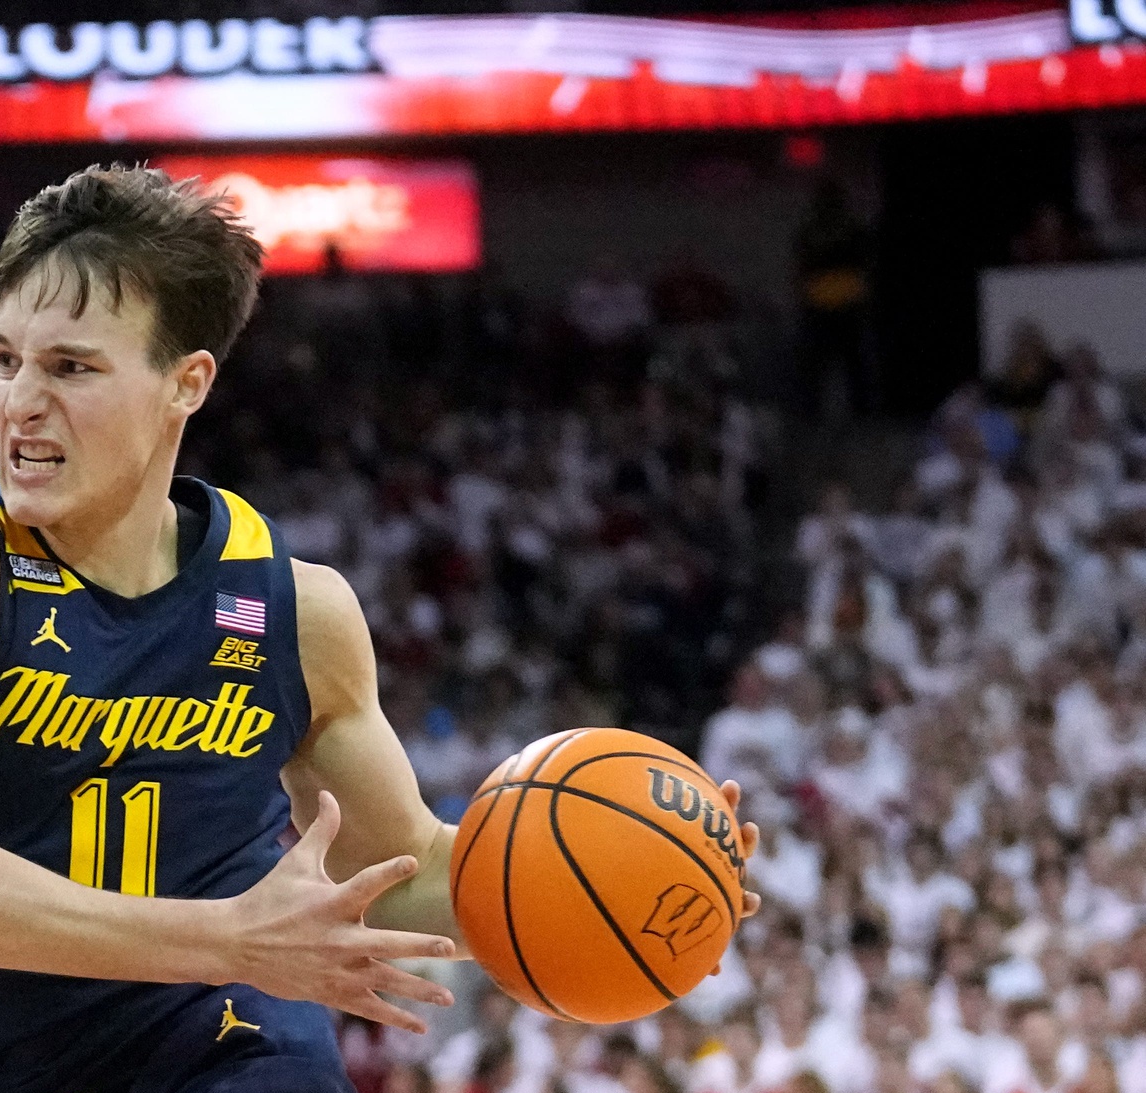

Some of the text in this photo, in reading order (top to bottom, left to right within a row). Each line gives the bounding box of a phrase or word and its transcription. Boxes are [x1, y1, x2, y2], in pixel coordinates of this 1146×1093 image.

[12, 567, 62, 584] CHANGE
[220, 636, 259, 653] BIG
[214, 648, 267, 667] EAST
[69, 777, 162, 898] 11
